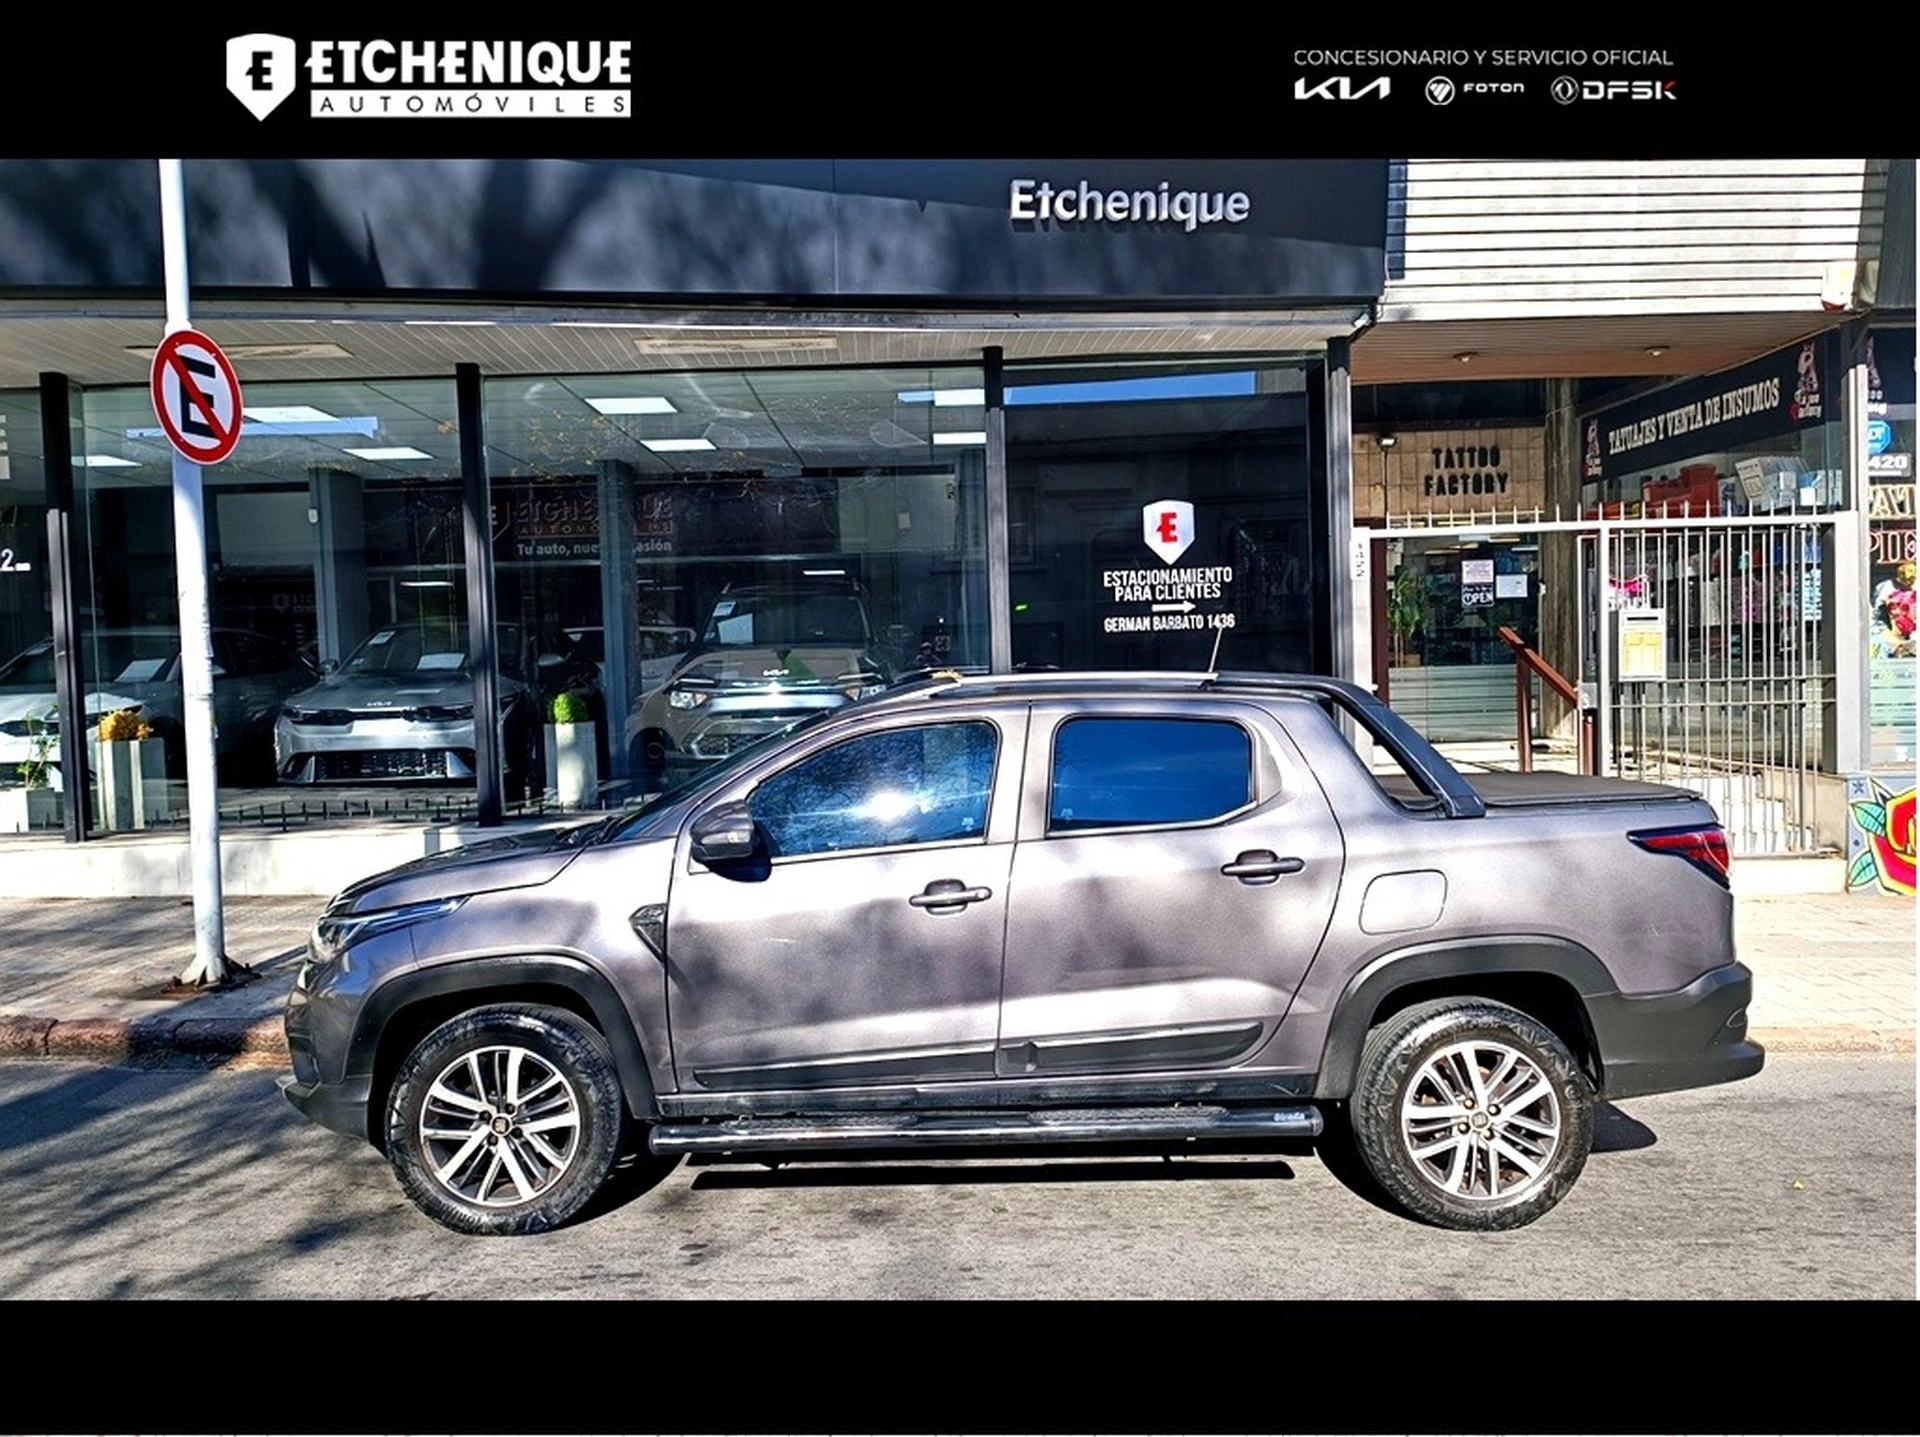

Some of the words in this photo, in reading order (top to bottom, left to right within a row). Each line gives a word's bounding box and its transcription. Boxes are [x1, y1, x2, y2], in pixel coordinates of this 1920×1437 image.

[1010, 179, 1251, 233] Etchenique
[1608, 415, 1658, 456] TATUAJES
[1656, 413, 1667, 442] Y
[1665, 406, 1704, 439] VENTA
[1704, 395, 1721, 427] DE
[1721, 377, 1780, 420] INSUMOS
[1432, 446, 1500, 468] TATTOO
[1424, 473, 1508, 496] FACTORY
[1102, 566, 1233, 588] ESTACIONAMIENTO
[1114, 585, 1152, 602] PARA
[1154, 582, 1222, 601] CLIENTES
[1103, 615, 1151, 633] GERMAN
[1152, 613, 1204, 631] BARBATO
